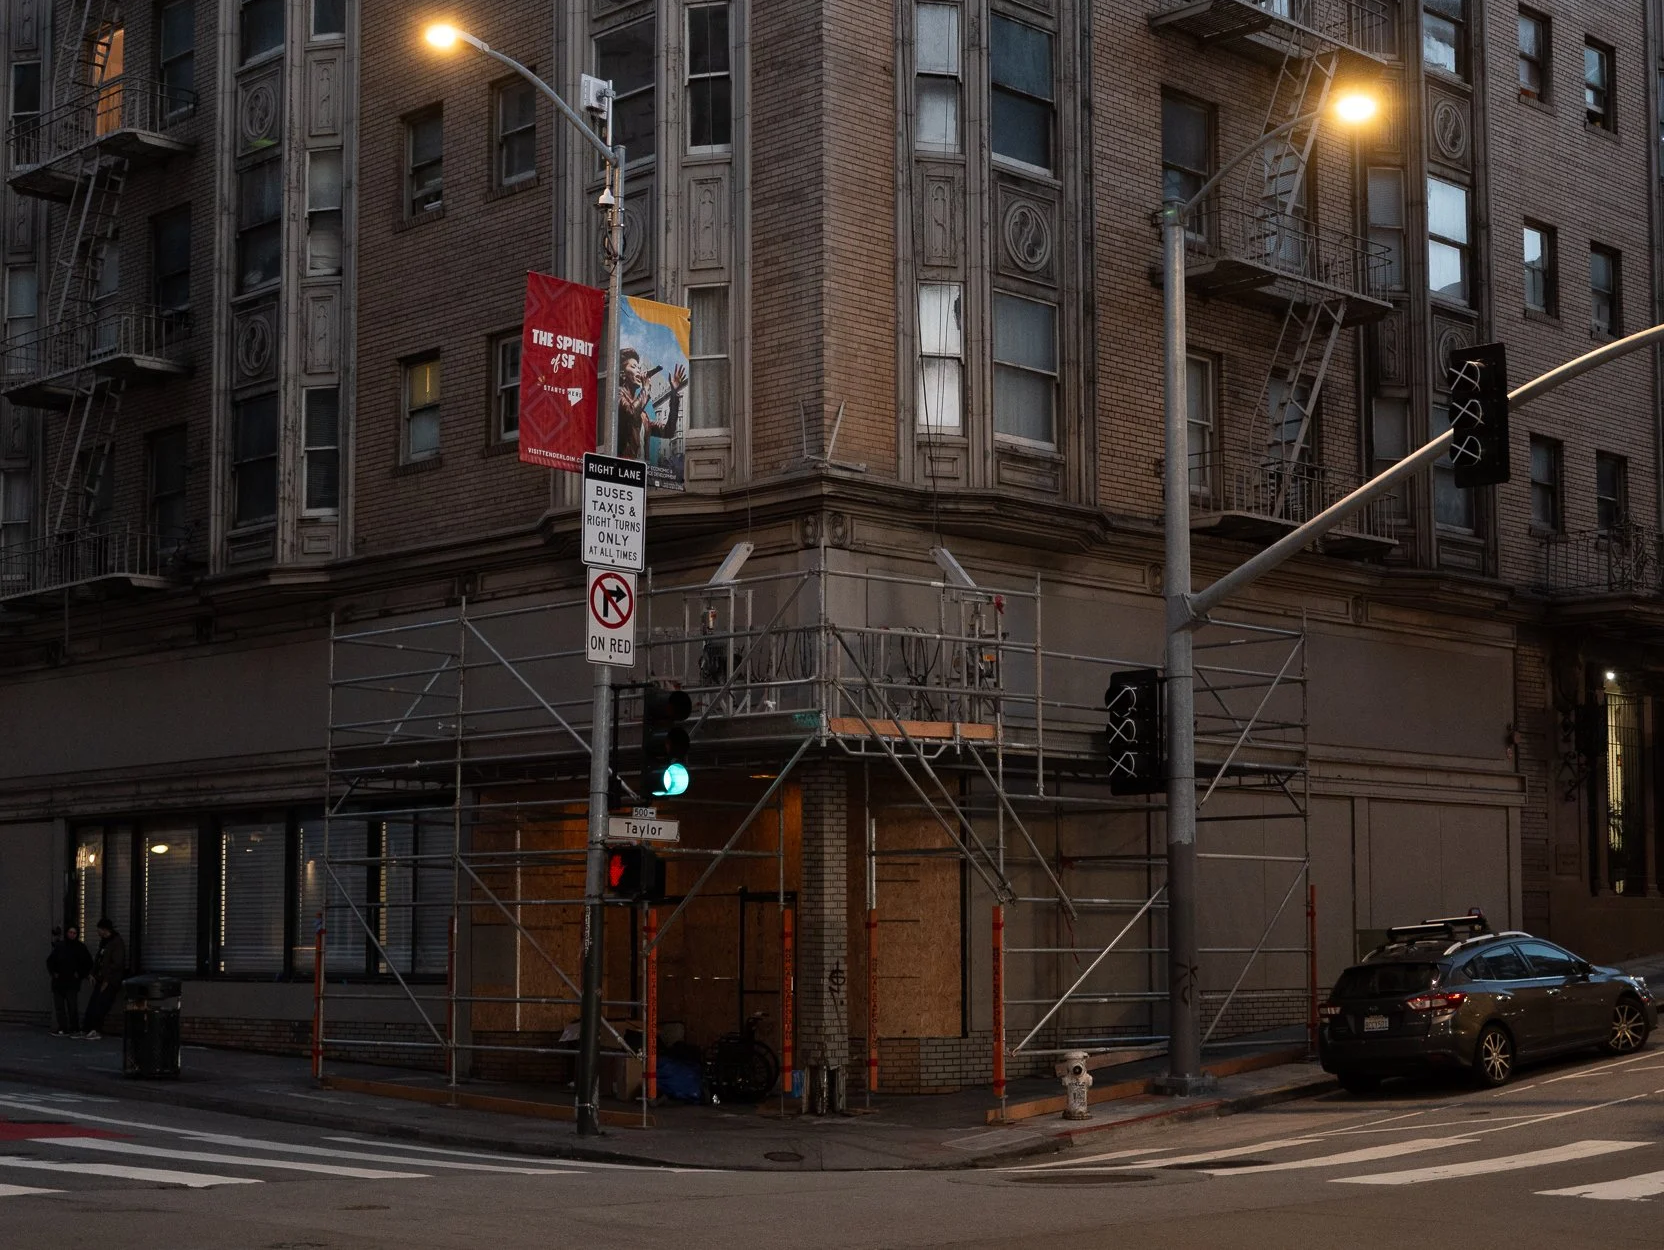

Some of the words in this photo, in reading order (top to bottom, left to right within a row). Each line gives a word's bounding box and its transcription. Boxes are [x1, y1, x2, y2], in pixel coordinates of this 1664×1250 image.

[532, 329, 554, 347] THE
[556, 334, 594, 358] SPIRIT
[550, 353, 562, 373] of
[561, 354, 576, 369] SF
[543, 384, 566, 395] STARTS
[568, 390, 582, 398] HERE
[527, 447, 583, 464] VISITTENDERLOIN.CO
[588, 462, 614, 476] RIGHT
[618, 468, 641, 481] LANE
[596, 485, 633, 501] BUSES
[592, 500, 625, 515] TAXIS
[629, 506, 636, 517] &
[587, 514, 611, 530] RIGHT
[614, 517, 641, 533] TURNS
[598, 531, 630, 547] ONLY
[588, 545, 598, 555] AT
[600, 547, 613, 558] ALL
[616, 548, 638, 561] TIMES
[590, 635, 605, 651] ON
[609, 638, 632, 654] RED
[634, 808, 648, 817] 500
[625, 822, 663, 837] Taylor
